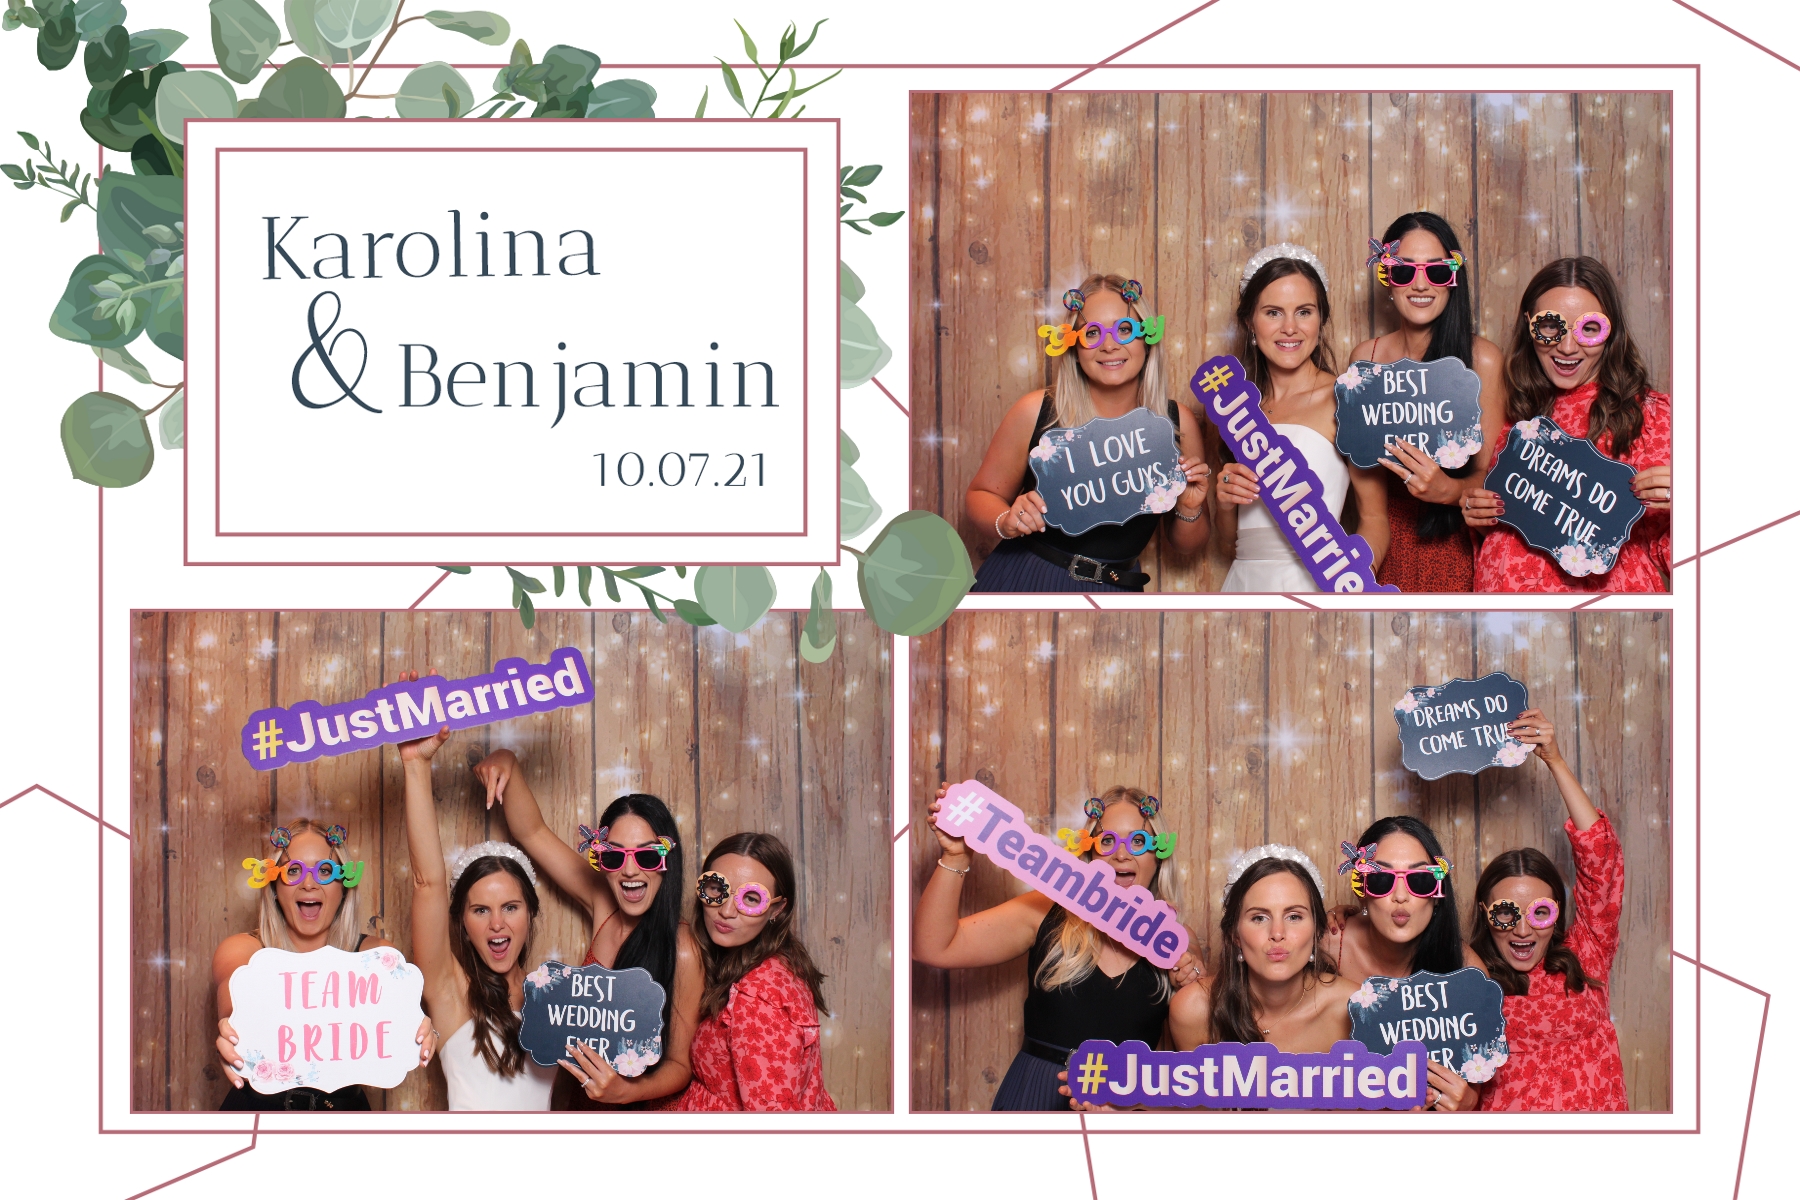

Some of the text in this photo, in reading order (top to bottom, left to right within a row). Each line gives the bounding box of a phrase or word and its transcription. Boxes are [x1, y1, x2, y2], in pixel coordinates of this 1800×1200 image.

[1383, 368, 1429, 397] BEST
[1361, 400, 1454, 426] WEDDING
[1064, 427, 1151, 474] I LOVE
[1060, 461, 1170, 511] YOU GUYS
[1519, 440, 1617, 514] DREAMS DO
[1504, 472, 1602, 547] COME TRUE
[252, 656, 586, 761] #JustMarried
[1413, 694, 1508, 729] DREAMS DO
[1419, 730, 1468, 756] COME
[945, 791, 1180, 960] #Teambride
[278, 970, 383, 1010] TEAM
[571, 973, 617, 1003] BEST
[1400, 980, 1449, 1012] BEST
[547, 1003, 636, 1033] WEDDING
[1379, 1012, 1478, 1046] WEDDING
[277, 1020, 393, 1063] BRIDE
[1076, 1052, 1417, 1099] #JustMarried
